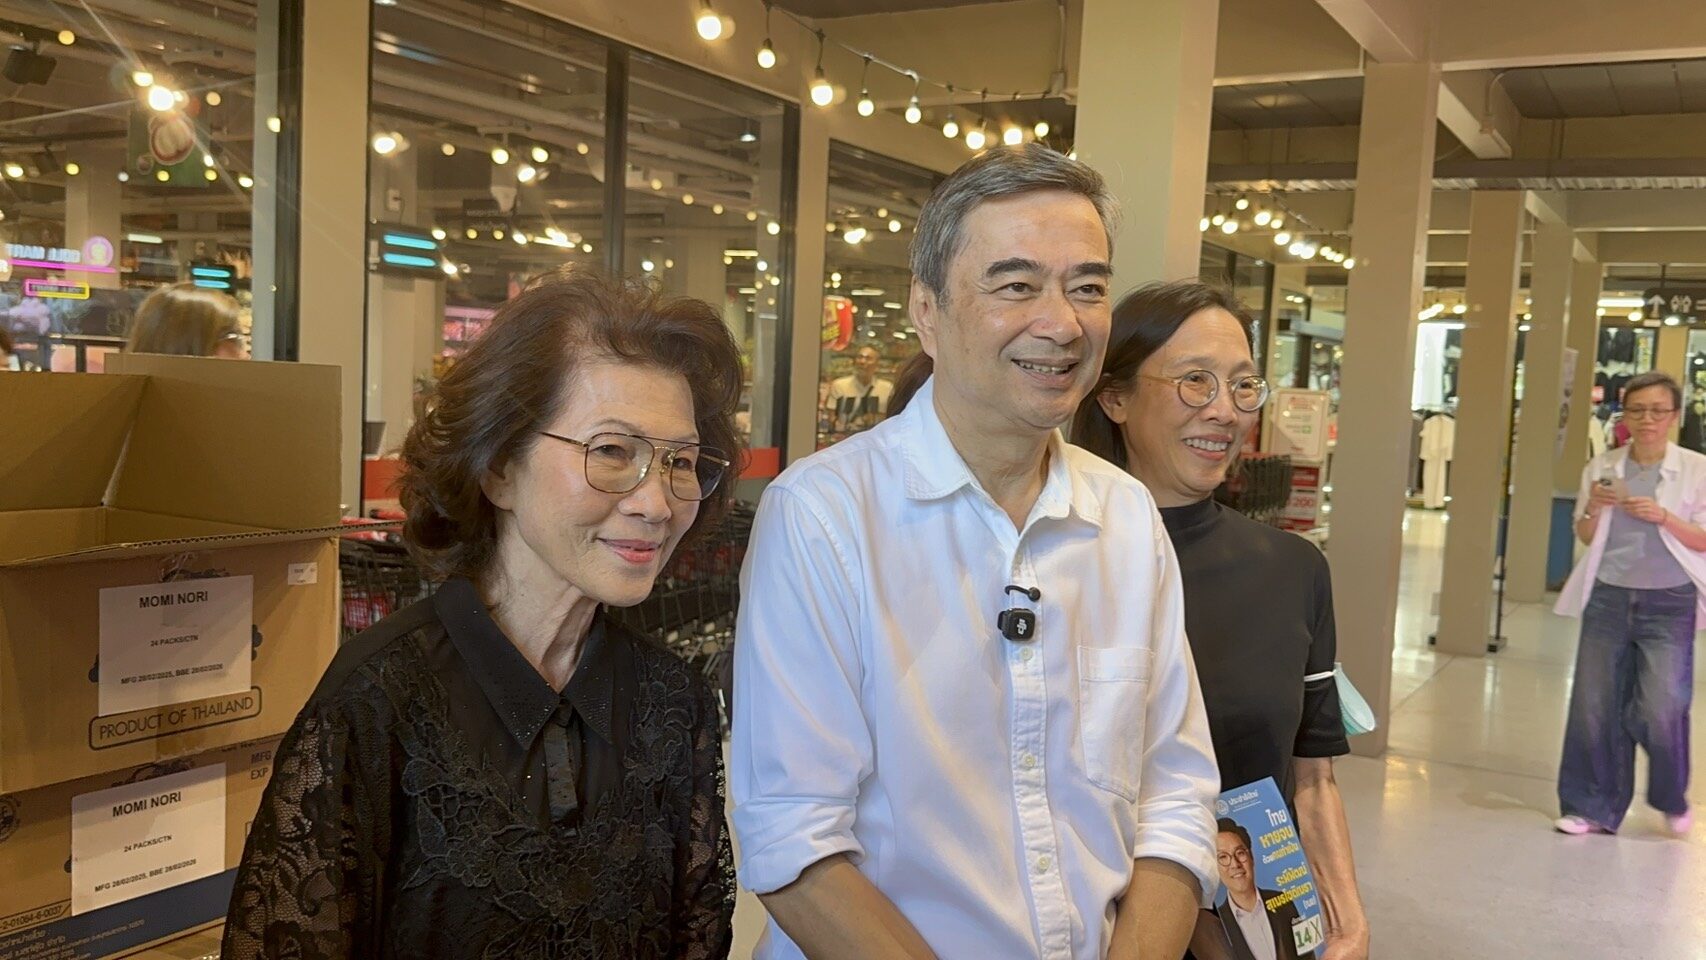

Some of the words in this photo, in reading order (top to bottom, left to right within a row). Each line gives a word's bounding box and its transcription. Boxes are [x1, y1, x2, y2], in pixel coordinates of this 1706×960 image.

[139, 594, 174, 608] MOMI
[178, 590, 208, 605] NORI
[99, 713, 164, 740] PRODUCT
[167, 707, 186, 725] OF
[191, 696, 254, 720] THAILAND
[251, 751, 272, 764] MFG
[251, 767, 268, 780] EXP
[112, 799, 147, 817] MOMI
[150, 791, 182, 808] NORI
[1265, 808, 1287, 828] ไทย
[124, 845, 132, 853] 24
[133, 834, 172, 851] PACKS/CTN
[94, 881, 110, 892] MFG
[1295, 927, 1312, 949] 14
